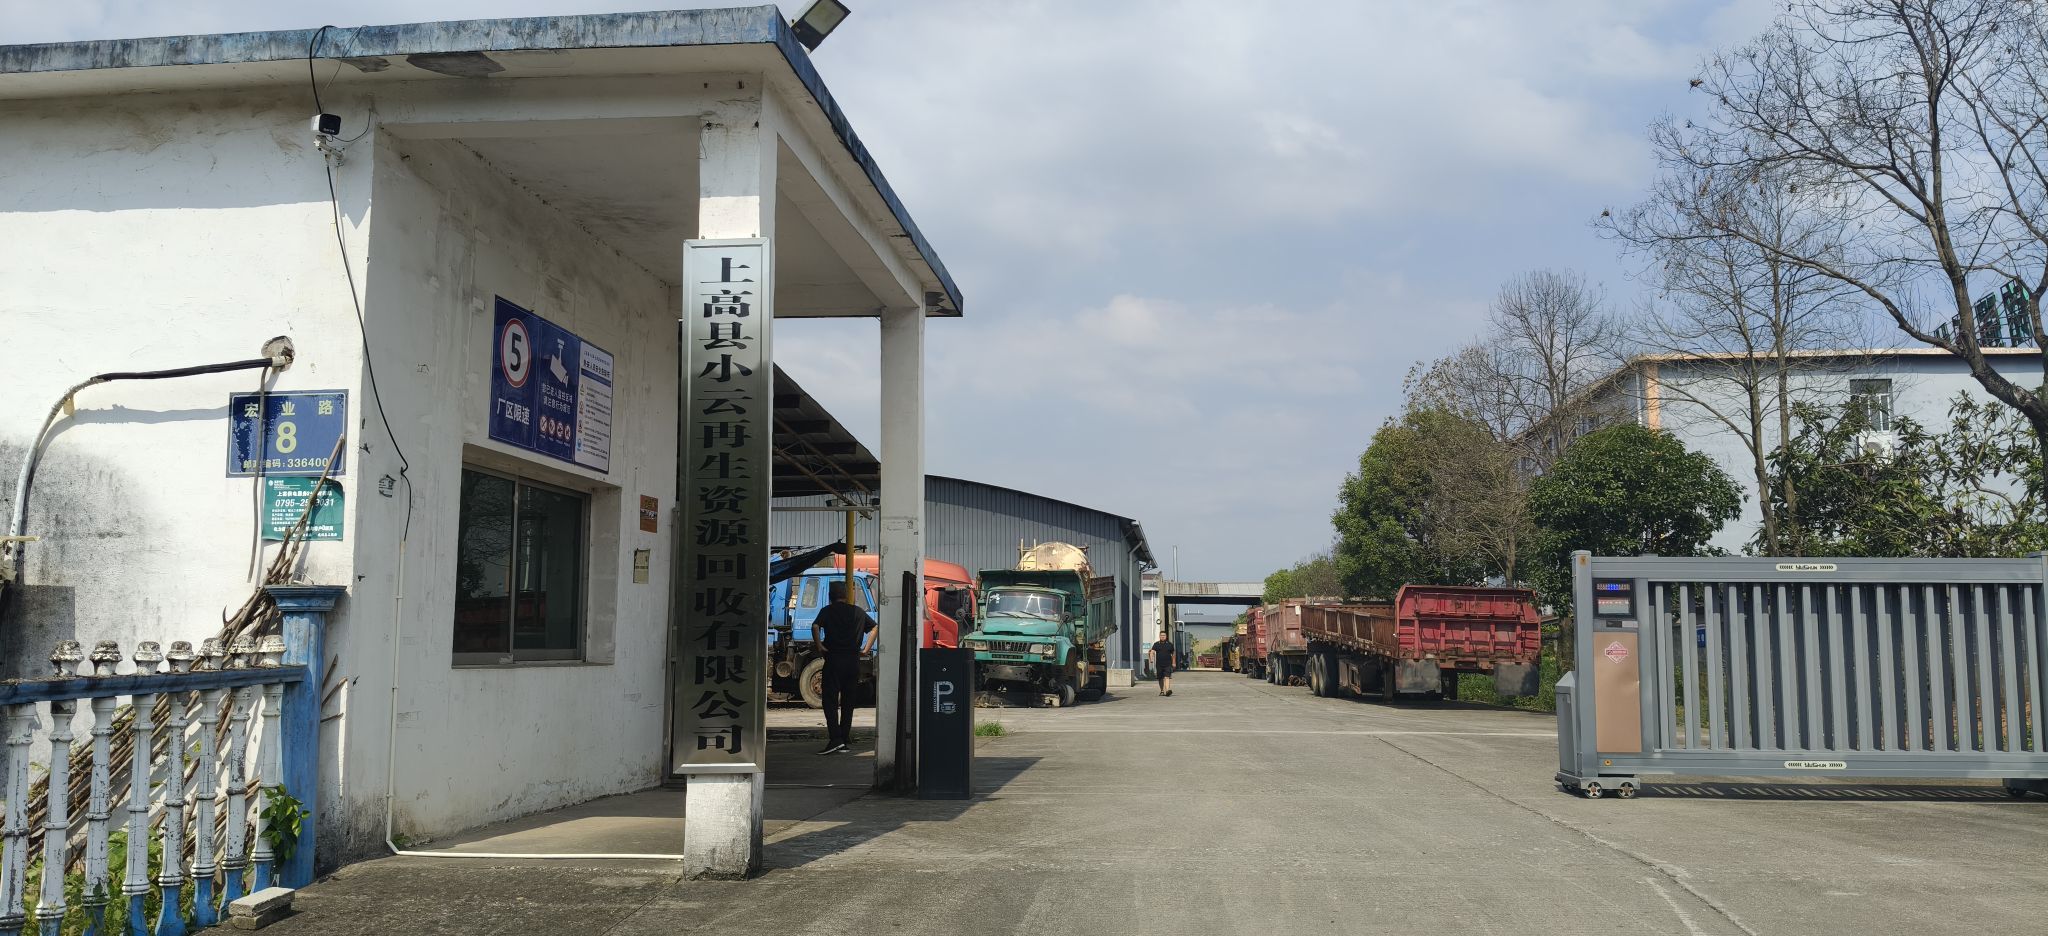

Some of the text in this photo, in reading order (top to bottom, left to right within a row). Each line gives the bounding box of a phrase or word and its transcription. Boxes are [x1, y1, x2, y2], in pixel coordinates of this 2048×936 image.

[510, 333, 522, 372] 5
[244, 399, 334, 418] 宏业路
[497, 398, 530, 425] 厂区限速
[276, 421, 297, 454] 8
[691, 257, 754, 754] 上高县小云再生资源回收有限公司
